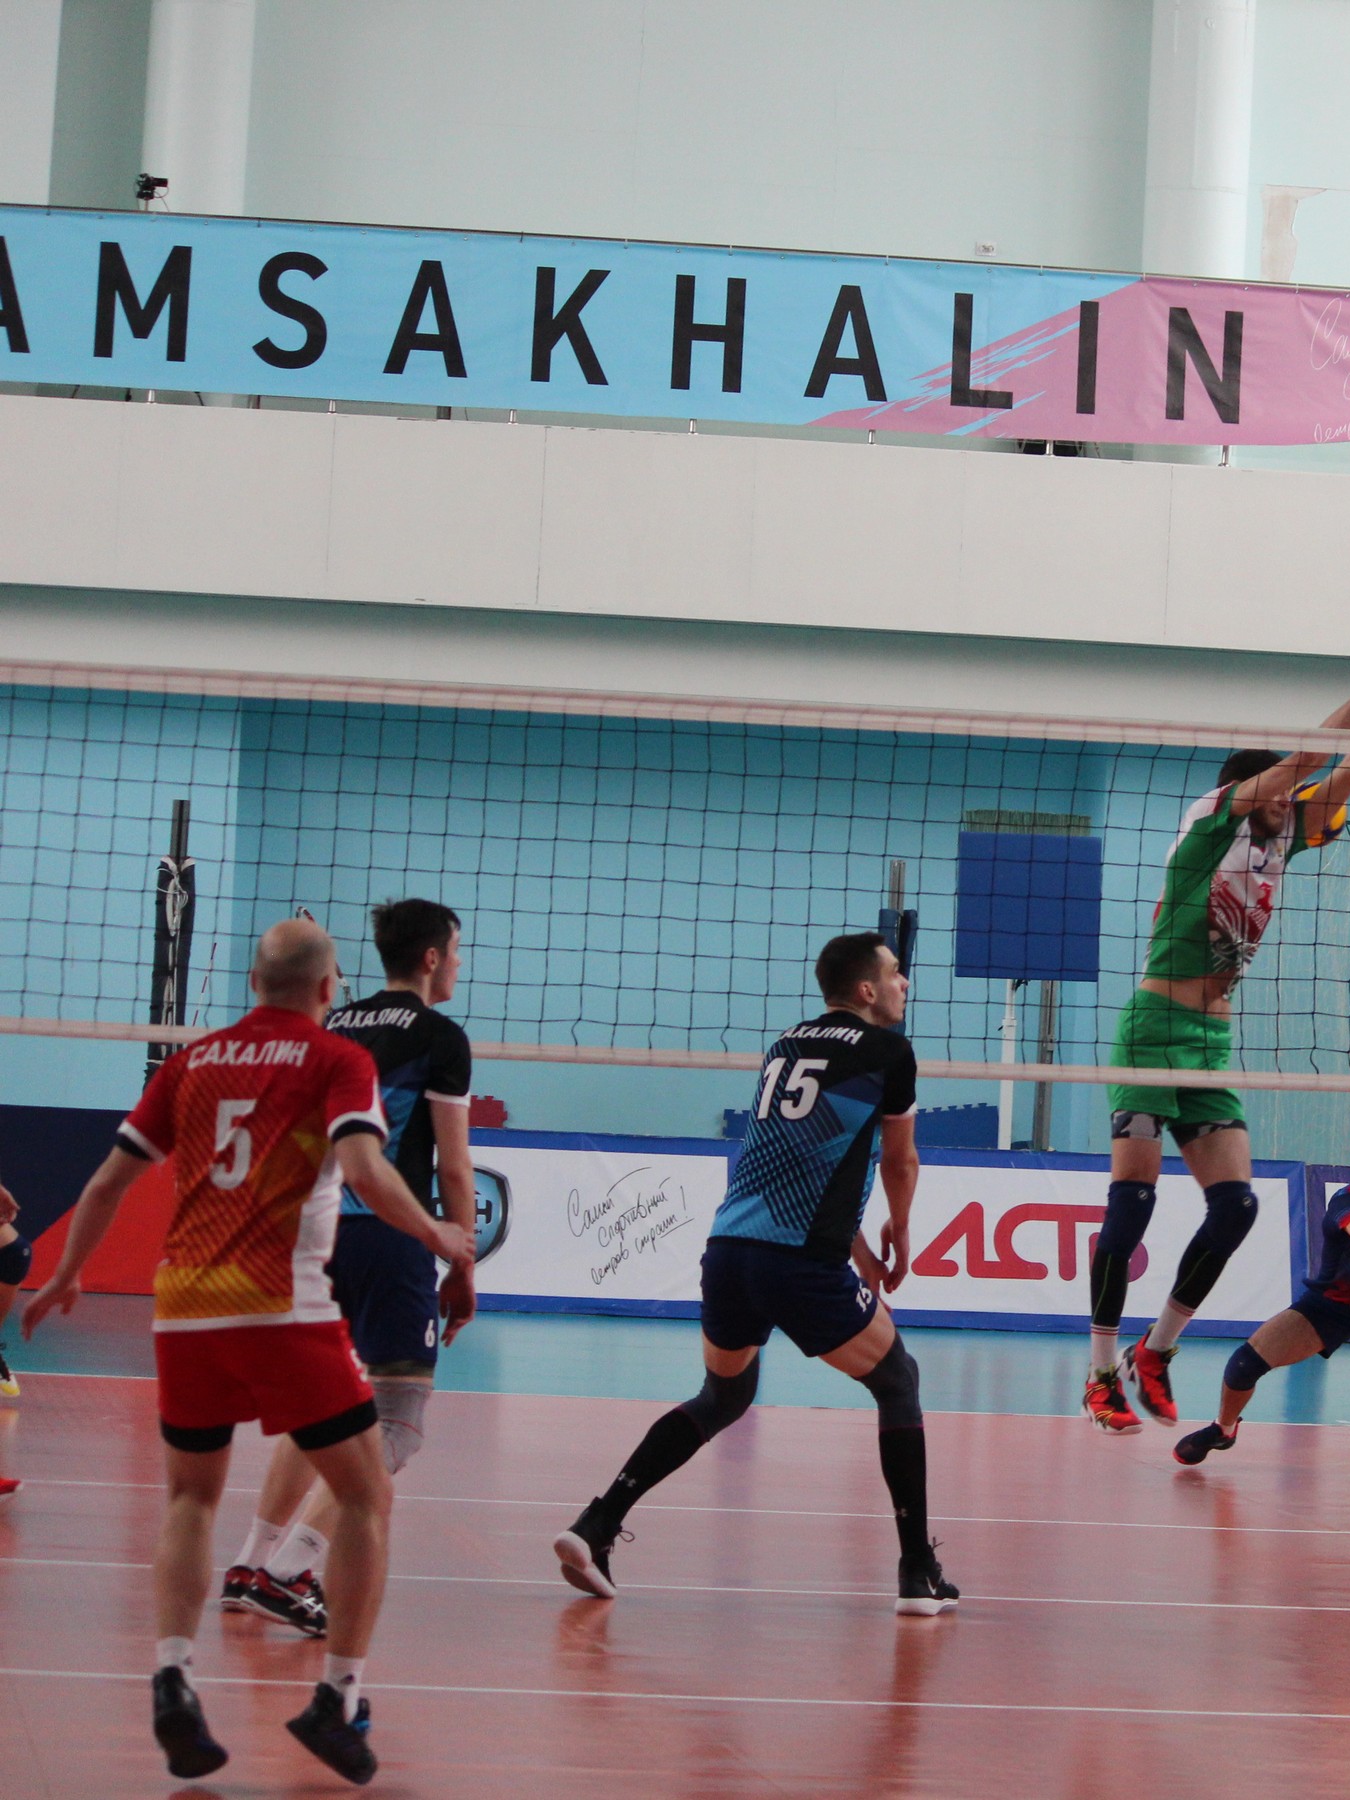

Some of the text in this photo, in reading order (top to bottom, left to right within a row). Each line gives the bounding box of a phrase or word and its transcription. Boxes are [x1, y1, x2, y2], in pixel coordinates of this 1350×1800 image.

[326, 1008, 418, 1030] САХАЛИН
[781, 1025, 864, 1045] АХАЛИН
[187, 1039, 310, 1070] САХАЛИН
[757, 1057, 829, 1120] 15
[210, 1099, 257, 1189] 5
[424, 1318, 436, 1348] 6
